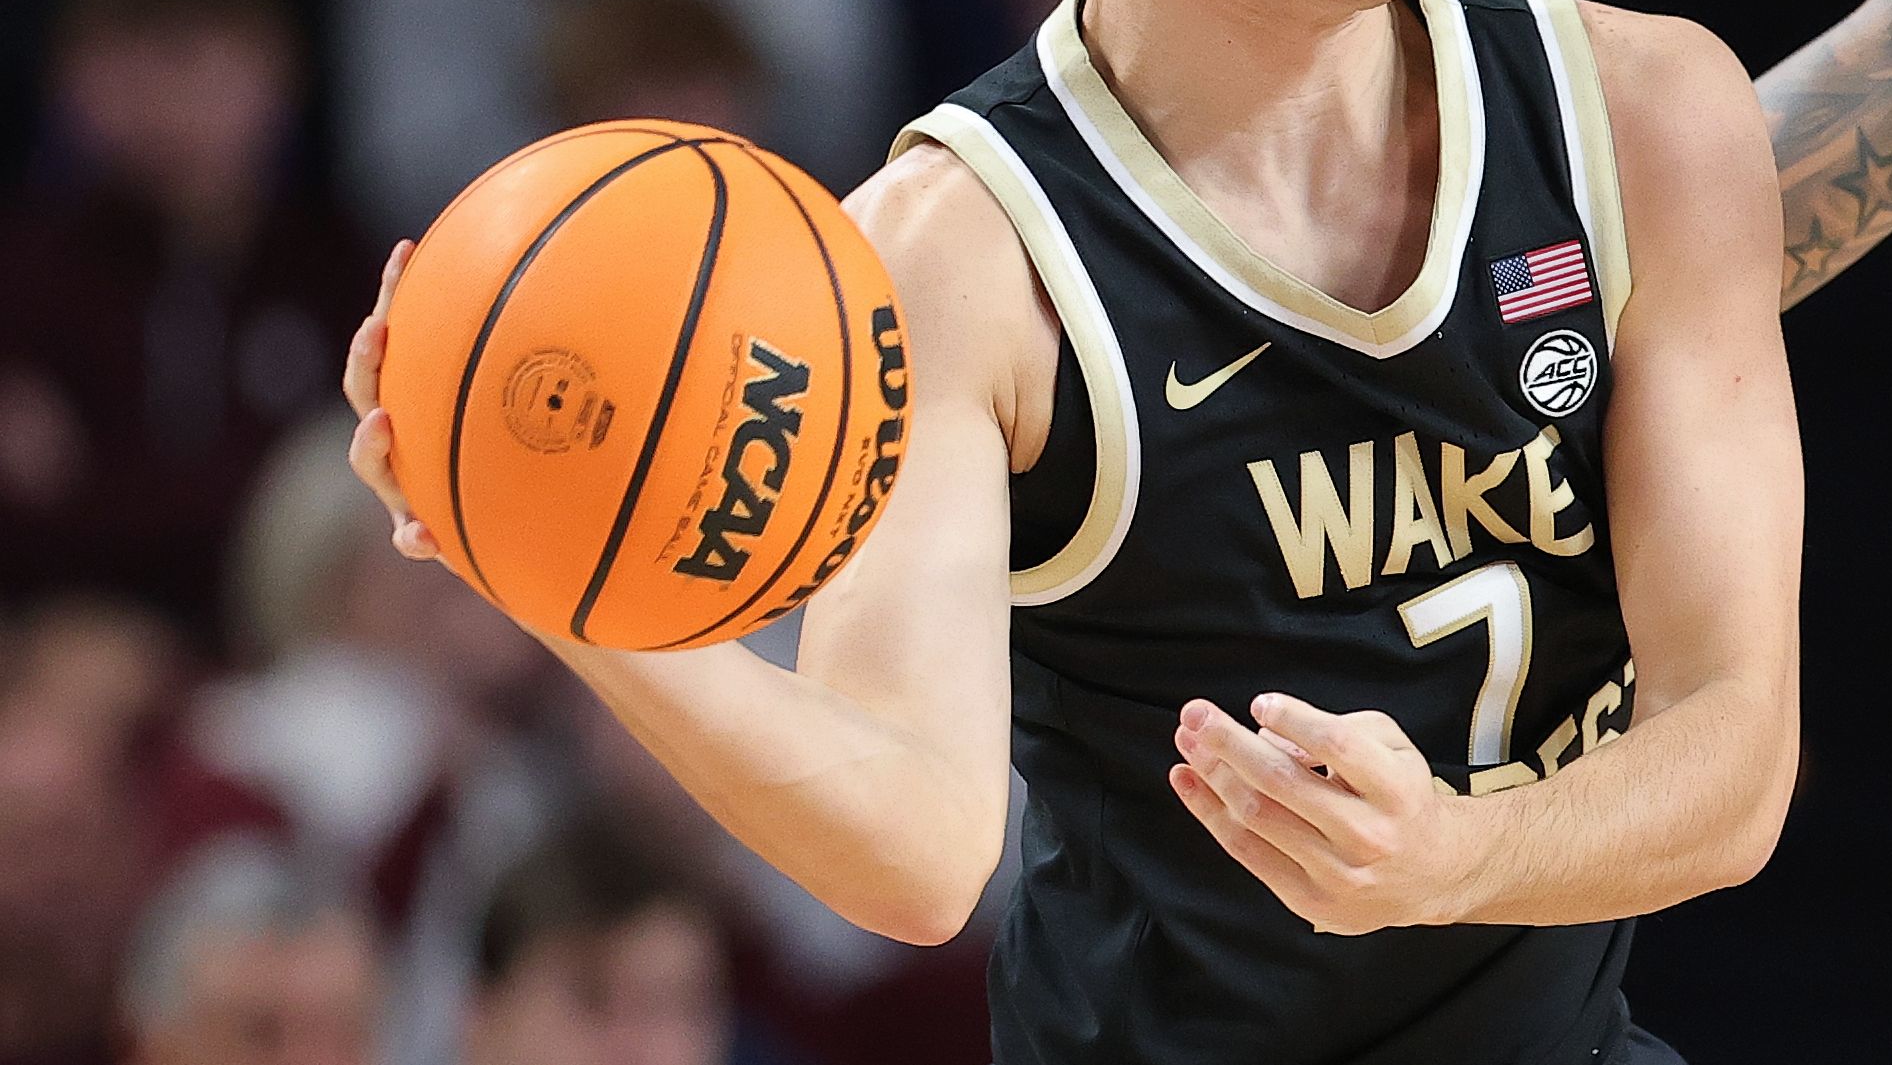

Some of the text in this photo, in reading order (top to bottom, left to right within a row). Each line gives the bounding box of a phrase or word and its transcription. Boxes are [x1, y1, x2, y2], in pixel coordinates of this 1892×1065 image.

[670, 337, 812, 582] NCAA
[1532, 353, 1592, 382] ACC
[1246, 424, 1595, 600] WAKE
[1397, 560, 1532, 766] 7
